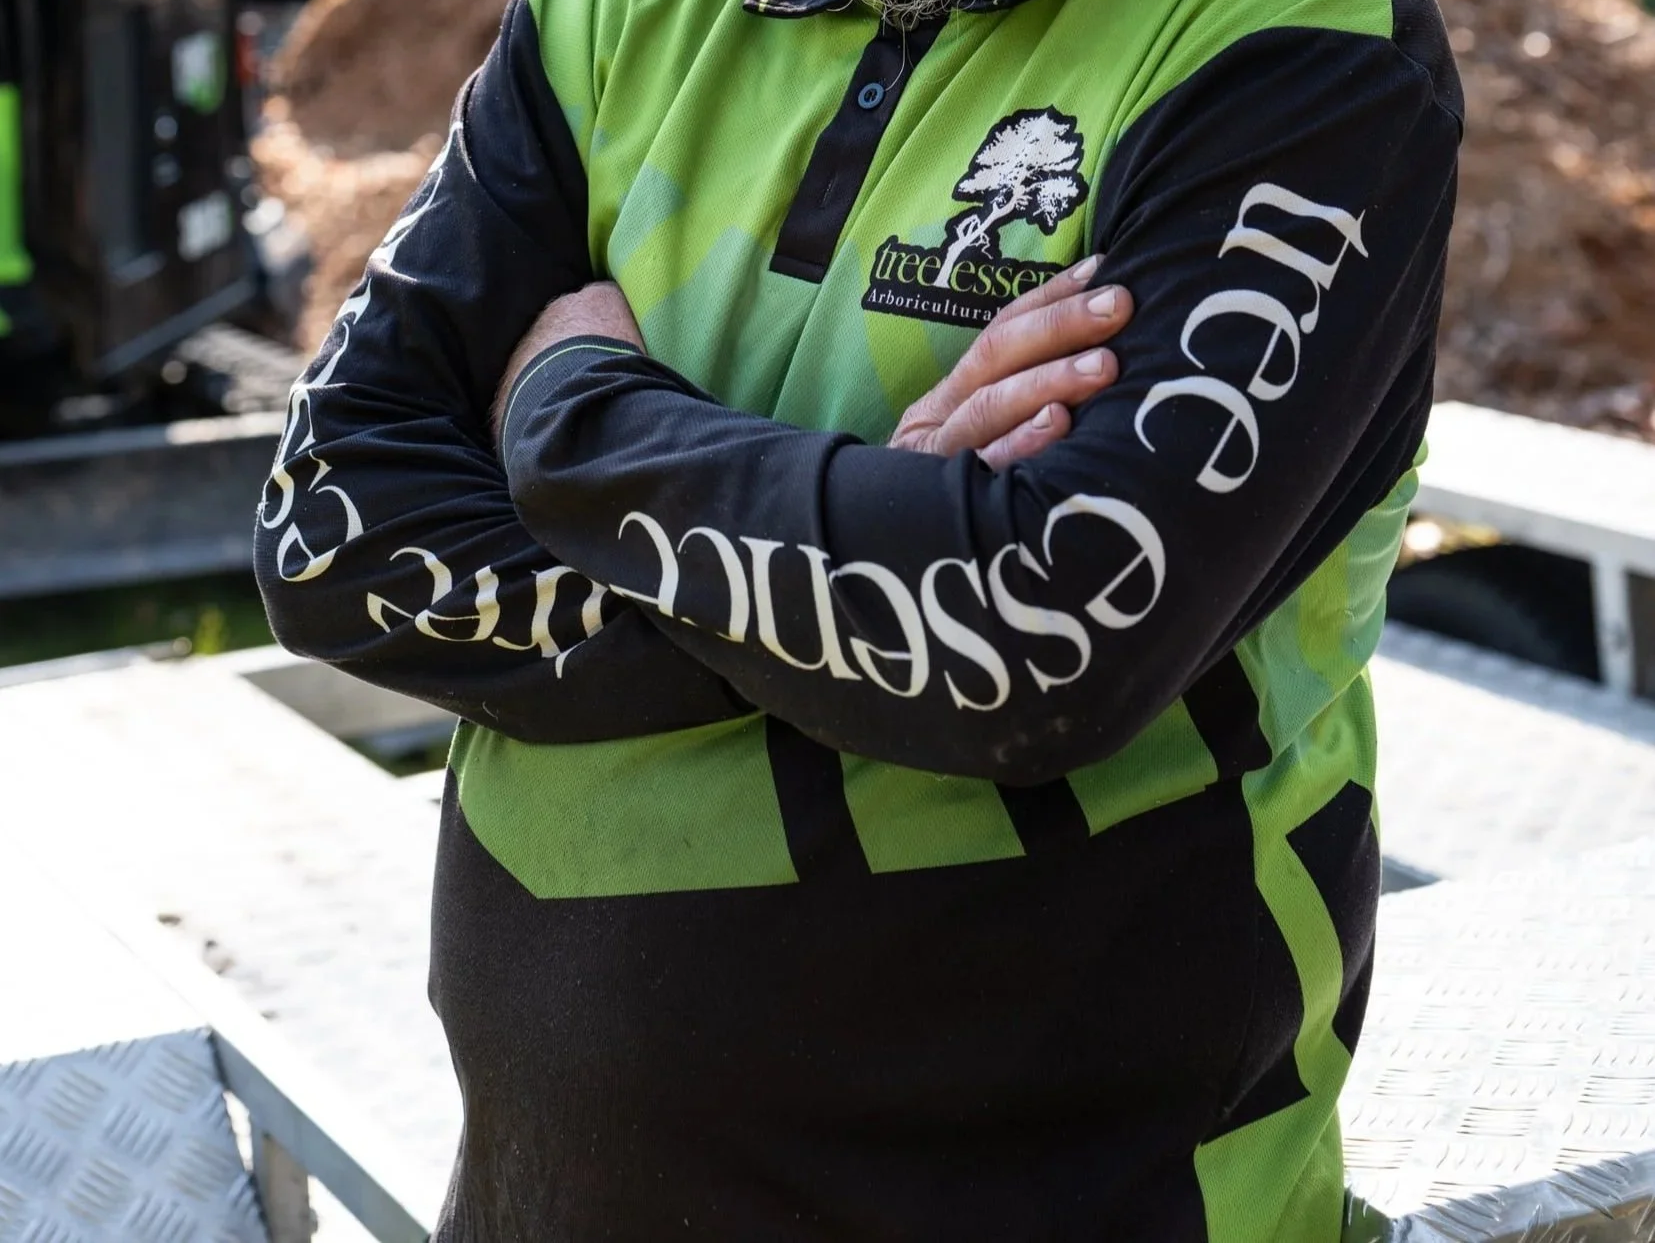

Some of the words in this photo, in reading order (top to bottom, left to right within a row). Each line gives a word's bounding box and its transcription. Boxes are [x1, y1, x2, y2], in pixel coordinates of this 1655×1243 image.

[875, 243, 941, 286] tree
[1135, 182, 1370, 494] tree
[609, 492, 1167, 712] essence
